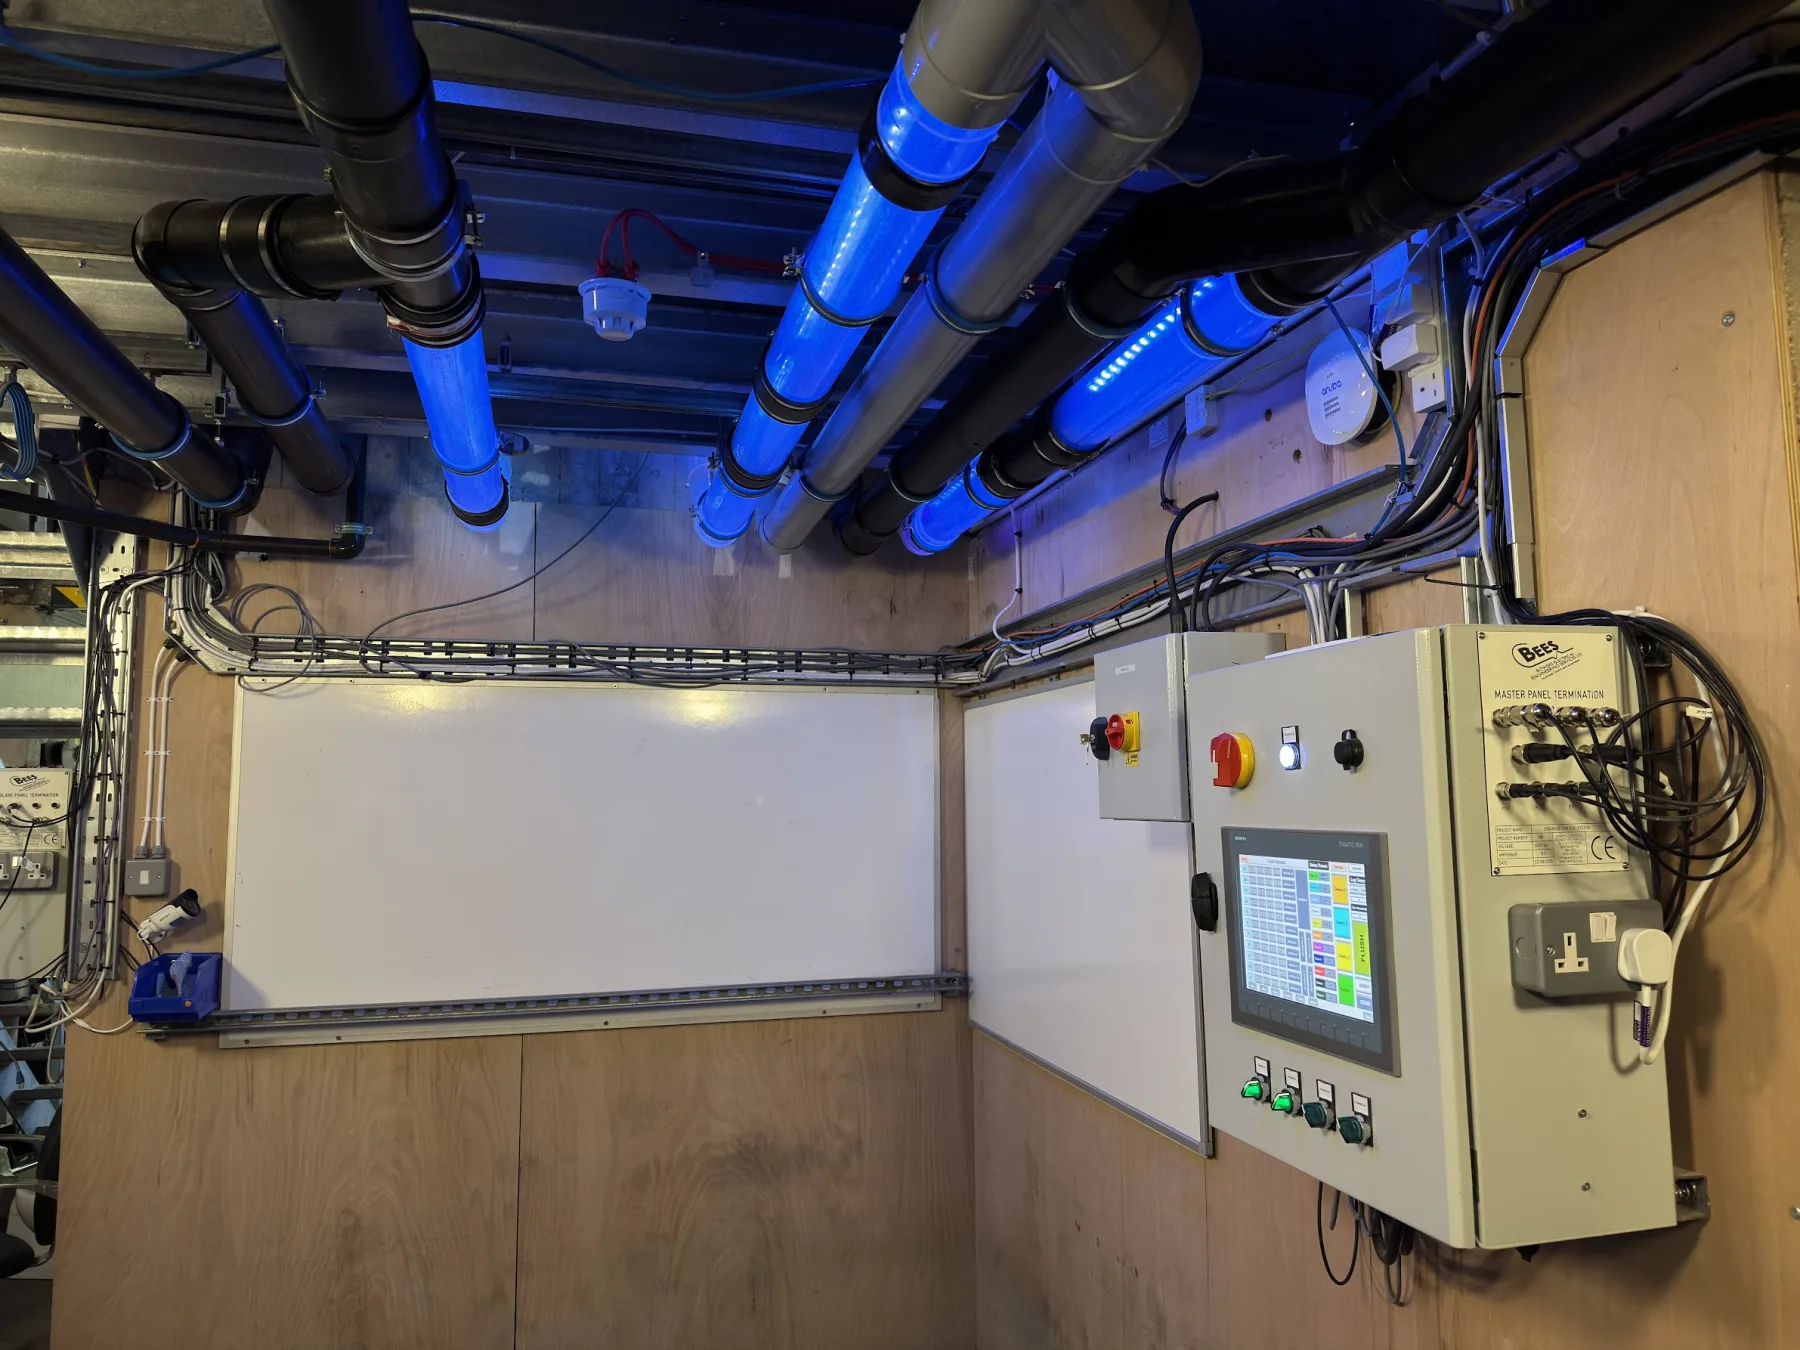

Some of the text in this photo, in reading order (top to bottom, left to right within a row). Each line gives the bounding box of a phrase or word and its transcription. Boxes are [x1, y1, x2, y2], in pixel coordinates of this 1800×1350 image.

[1321, 380, 1342, 396] aruba
[1518, 640, 1559, 663] BEES
[1494, 690, 1604, 699] MASTER PANEL TERMINATION
[14, 775, 38, 785] BEES
[1591, 835, 1616, 860] CE
